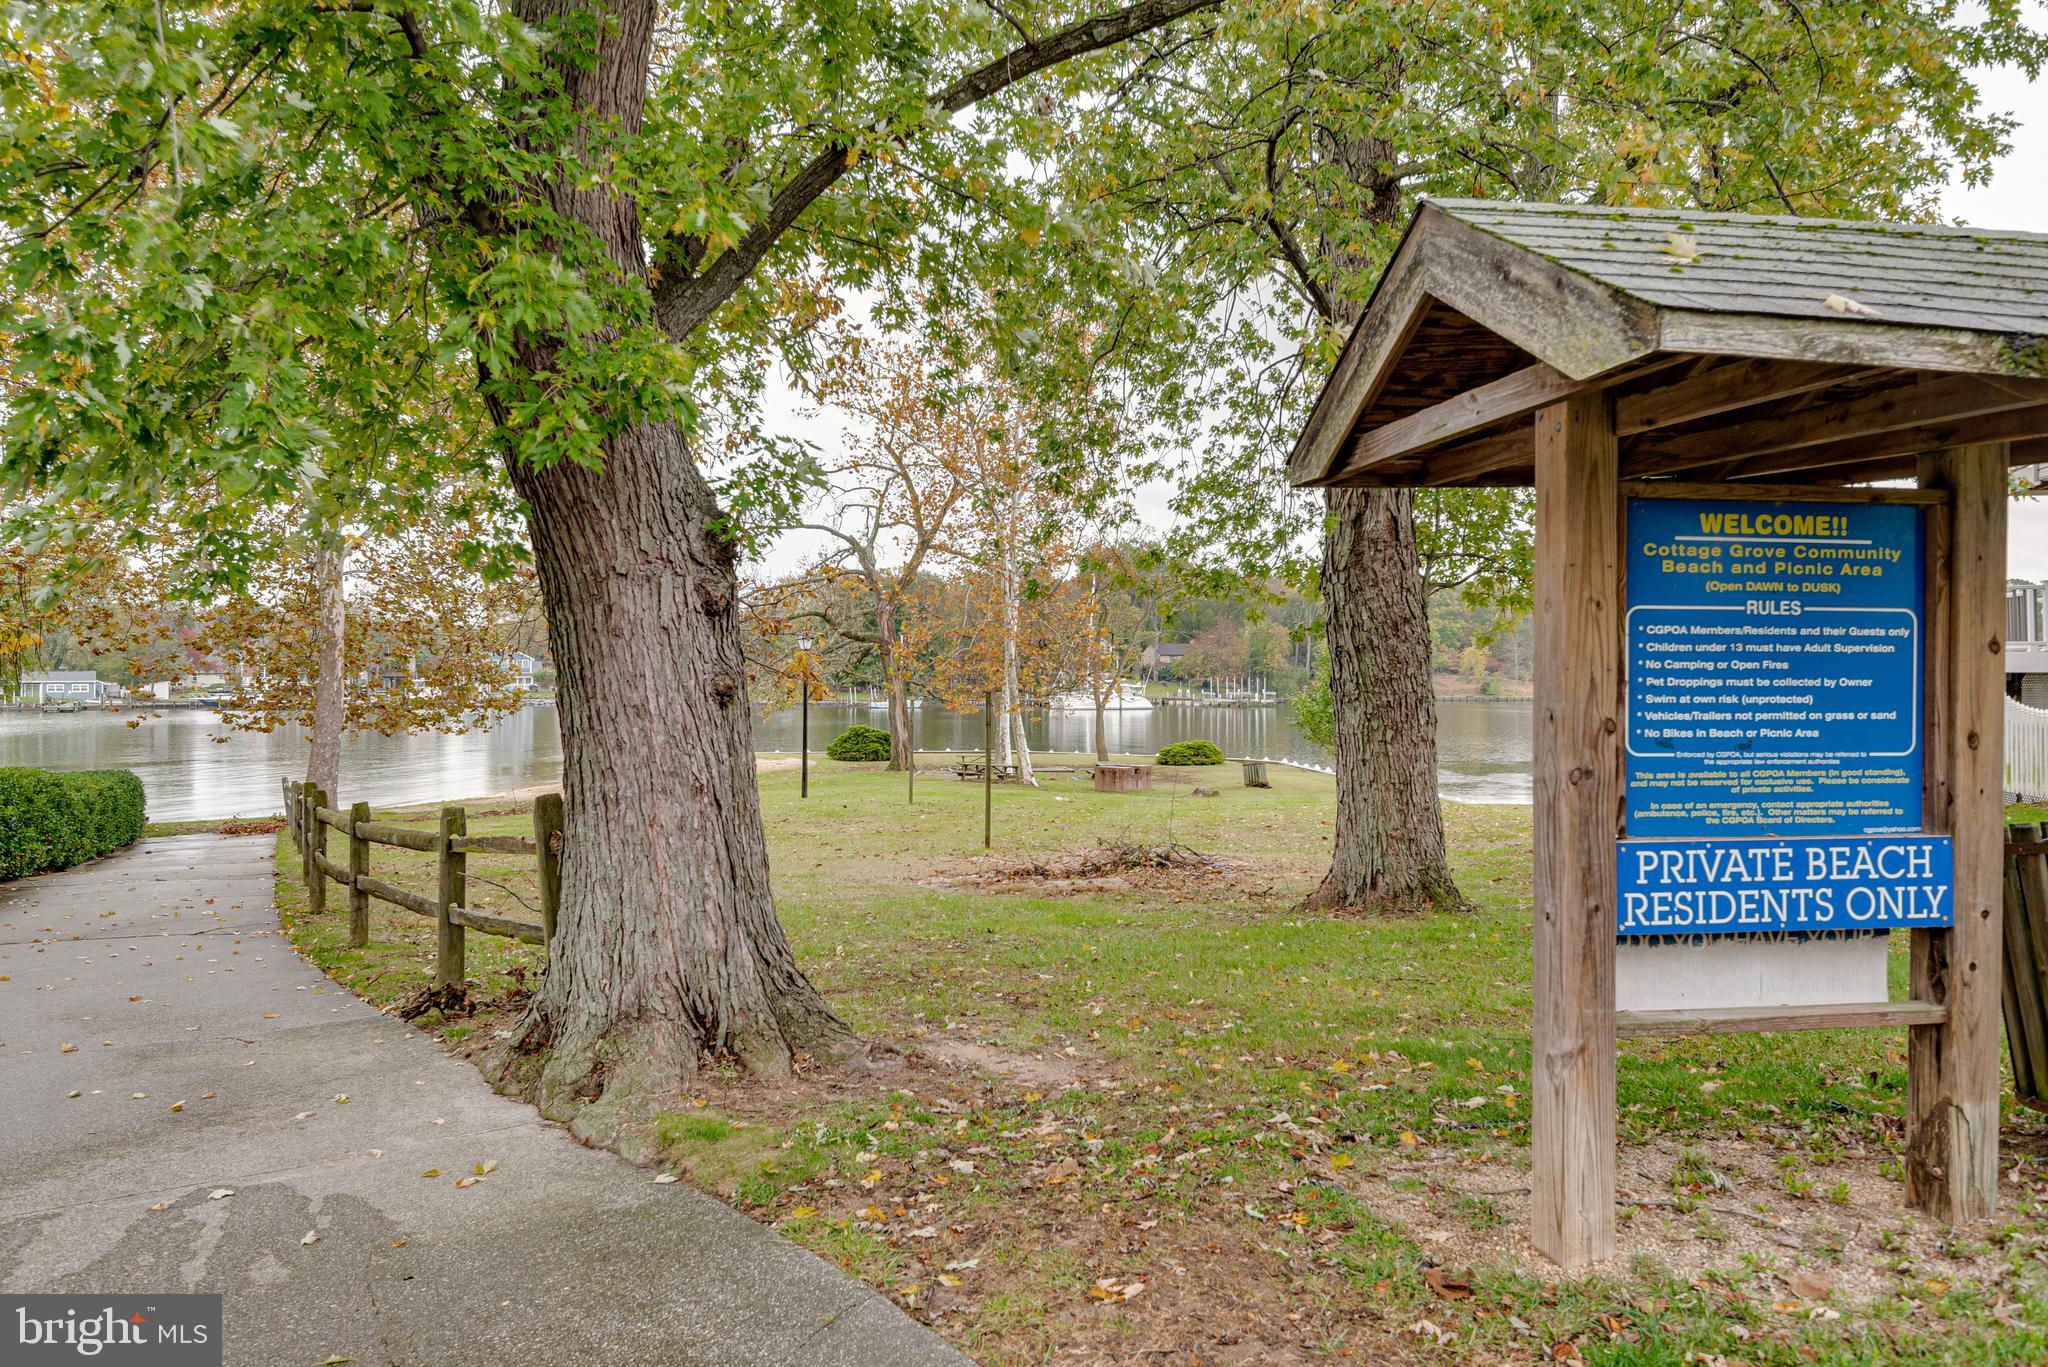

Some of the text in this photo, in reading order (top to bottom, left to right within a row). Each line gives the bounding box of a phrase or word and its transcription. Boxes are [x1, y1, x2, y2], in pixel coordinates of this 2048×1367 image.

[1700, 513, 1847, 536] WELCOME!!
[1644, 543, 1901, 562] Cottage Grove Community
[1662, 560, 1882, 576] Beach and Picnic Area
[1706, 580, 1840, 594] (Open DAWN to DUSK)
[1746, 600, 1801, 615] RULES
[1646, 624, 1910, 638] CGPOA Members/Residents and their Guests only
[1646, 642, 1896, 654] Children under 13 must have Adult Supervision
[1644, 660, 1790, 671] No Camping or Open Fires
[1646, 677, 1873, 688] Pet Droppings must be collected by Owner
[1645, 694, 1814, 706] Swim at own risk (unprotected)
[1644, 710, 1732, 720] Vehicles/Trailers
[1734, 712, 1753, 720] not
[1754, 711, 1806, 722] permitted
[1824, 712, 1855, 722] grass
[1856, 712, 1868, 720] or
[1870, 710, 1897, 720] sand
[1644, 728, 1820, 738] No Bikes in Beach or Picnic Area
[1636, 845, 1933, 884] PRIVATE BEACH
[1624, 885, 1948, 926] RESIDENTS ONLY
